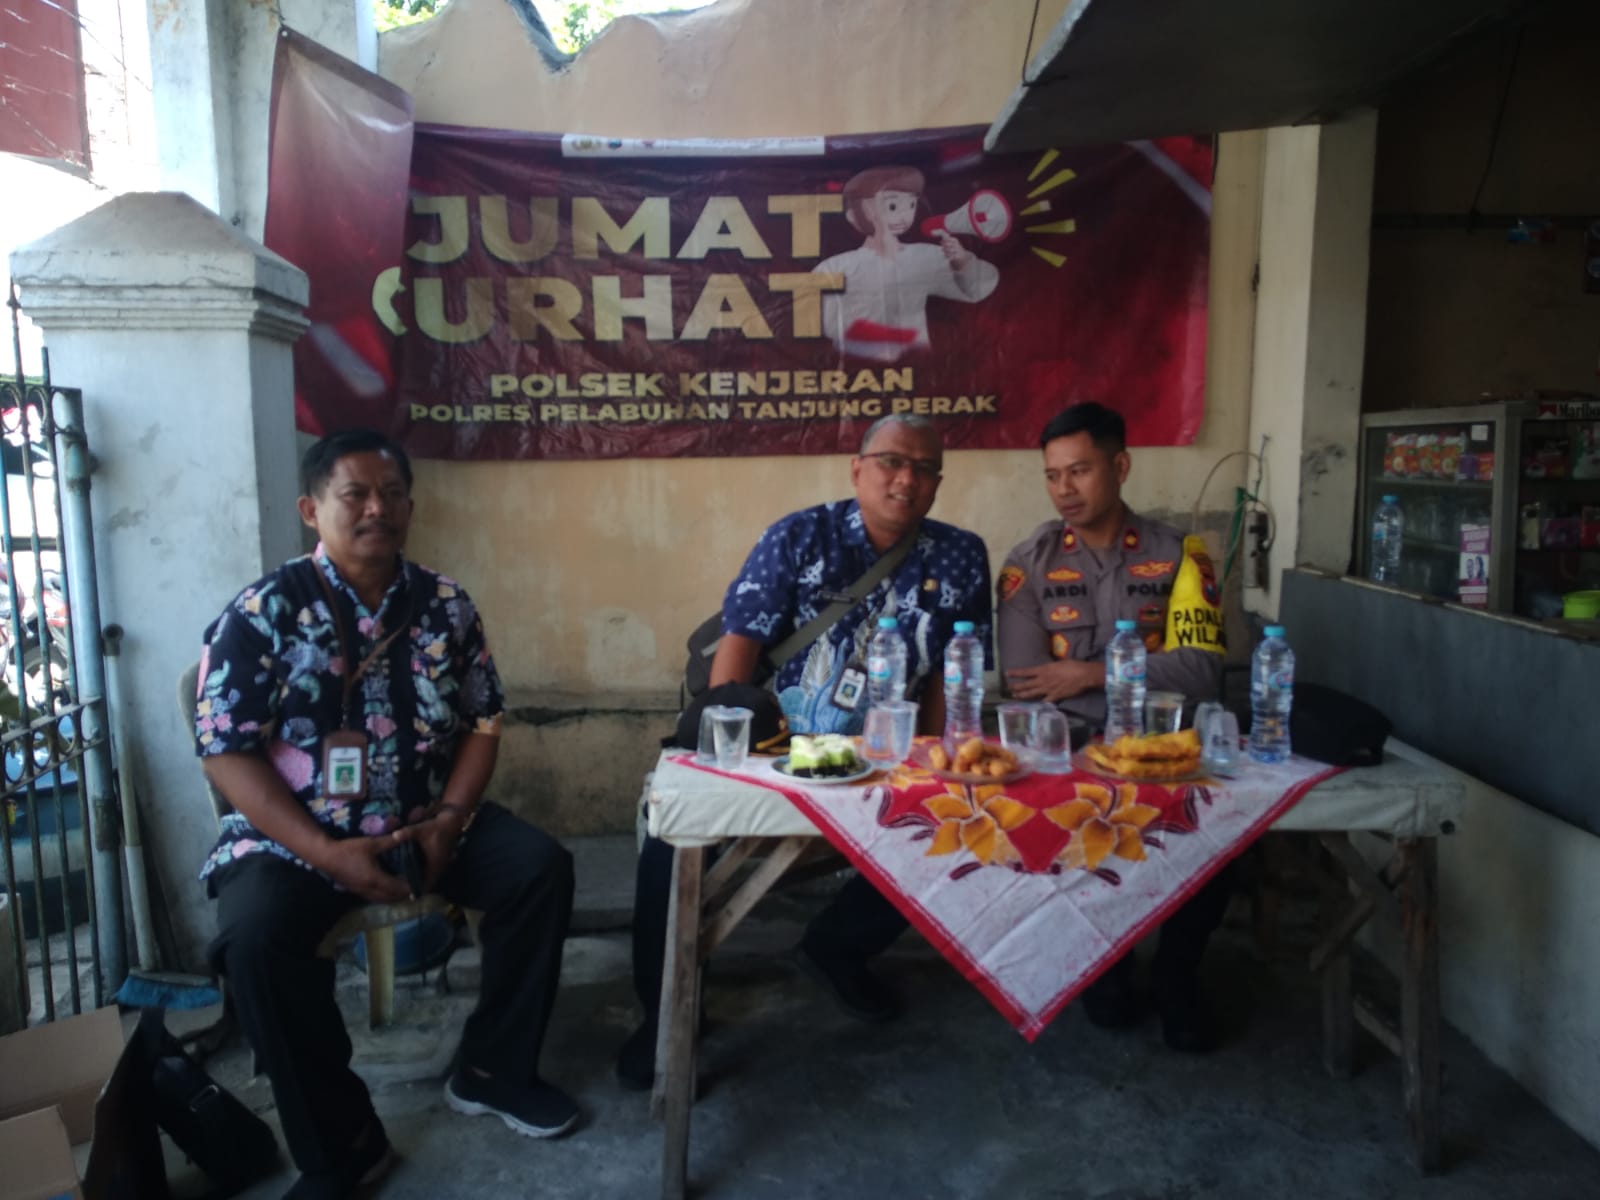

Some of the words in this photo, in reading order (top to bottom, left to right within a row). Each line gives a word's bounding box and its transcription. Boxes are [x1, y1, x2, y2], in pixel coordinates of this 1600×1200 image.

[406, 194, 844, 264] JUMAT
[490, 372, 664, 399] POLSEK
[680, 366, 914, 398] KENJERAN
[410, 402, 532, 423] POLRES
[540, 401, 730, 422] PELABUHAN
[738, 397, 882, 420] TANJUNG
[892, 394, 998, 415] PERAK
[1042, 583, 1088, 599] ARDI
